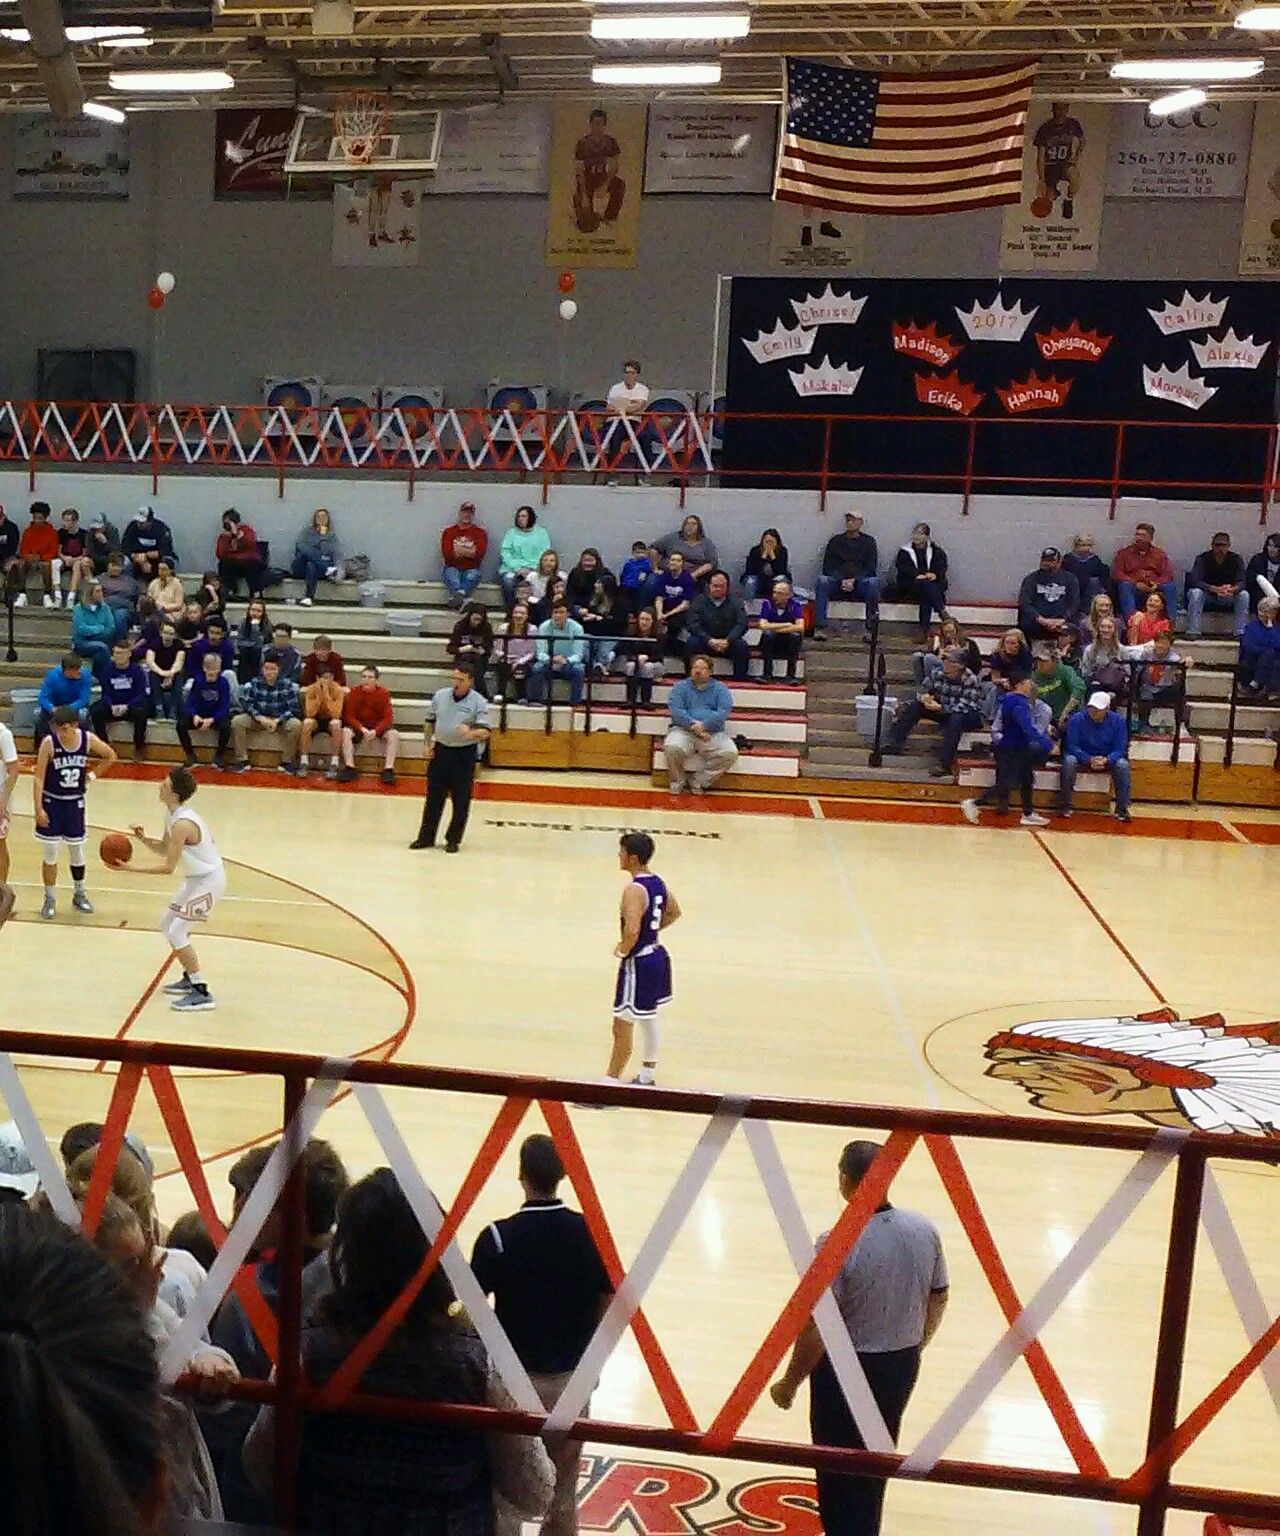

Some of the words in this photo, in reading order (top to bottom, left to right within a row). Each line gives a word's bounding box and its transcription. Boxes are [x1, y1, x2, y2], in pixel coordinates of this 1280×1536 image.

[1118, 151, 1237, 165] 256-737-0880
[972, 313, 1019, 329] 2017
[1163, 308, 1215, 328] Callie
[894, 335, 950, 363] Madison
[1042, 336, 1102, 357] Cheyanne
[928, 389, 963, 411] Erika
[1007, 388, 1060, 410] Hannah
[53, 754, 88, 770] HAWKS
[59, 768, 80, 788] 32
